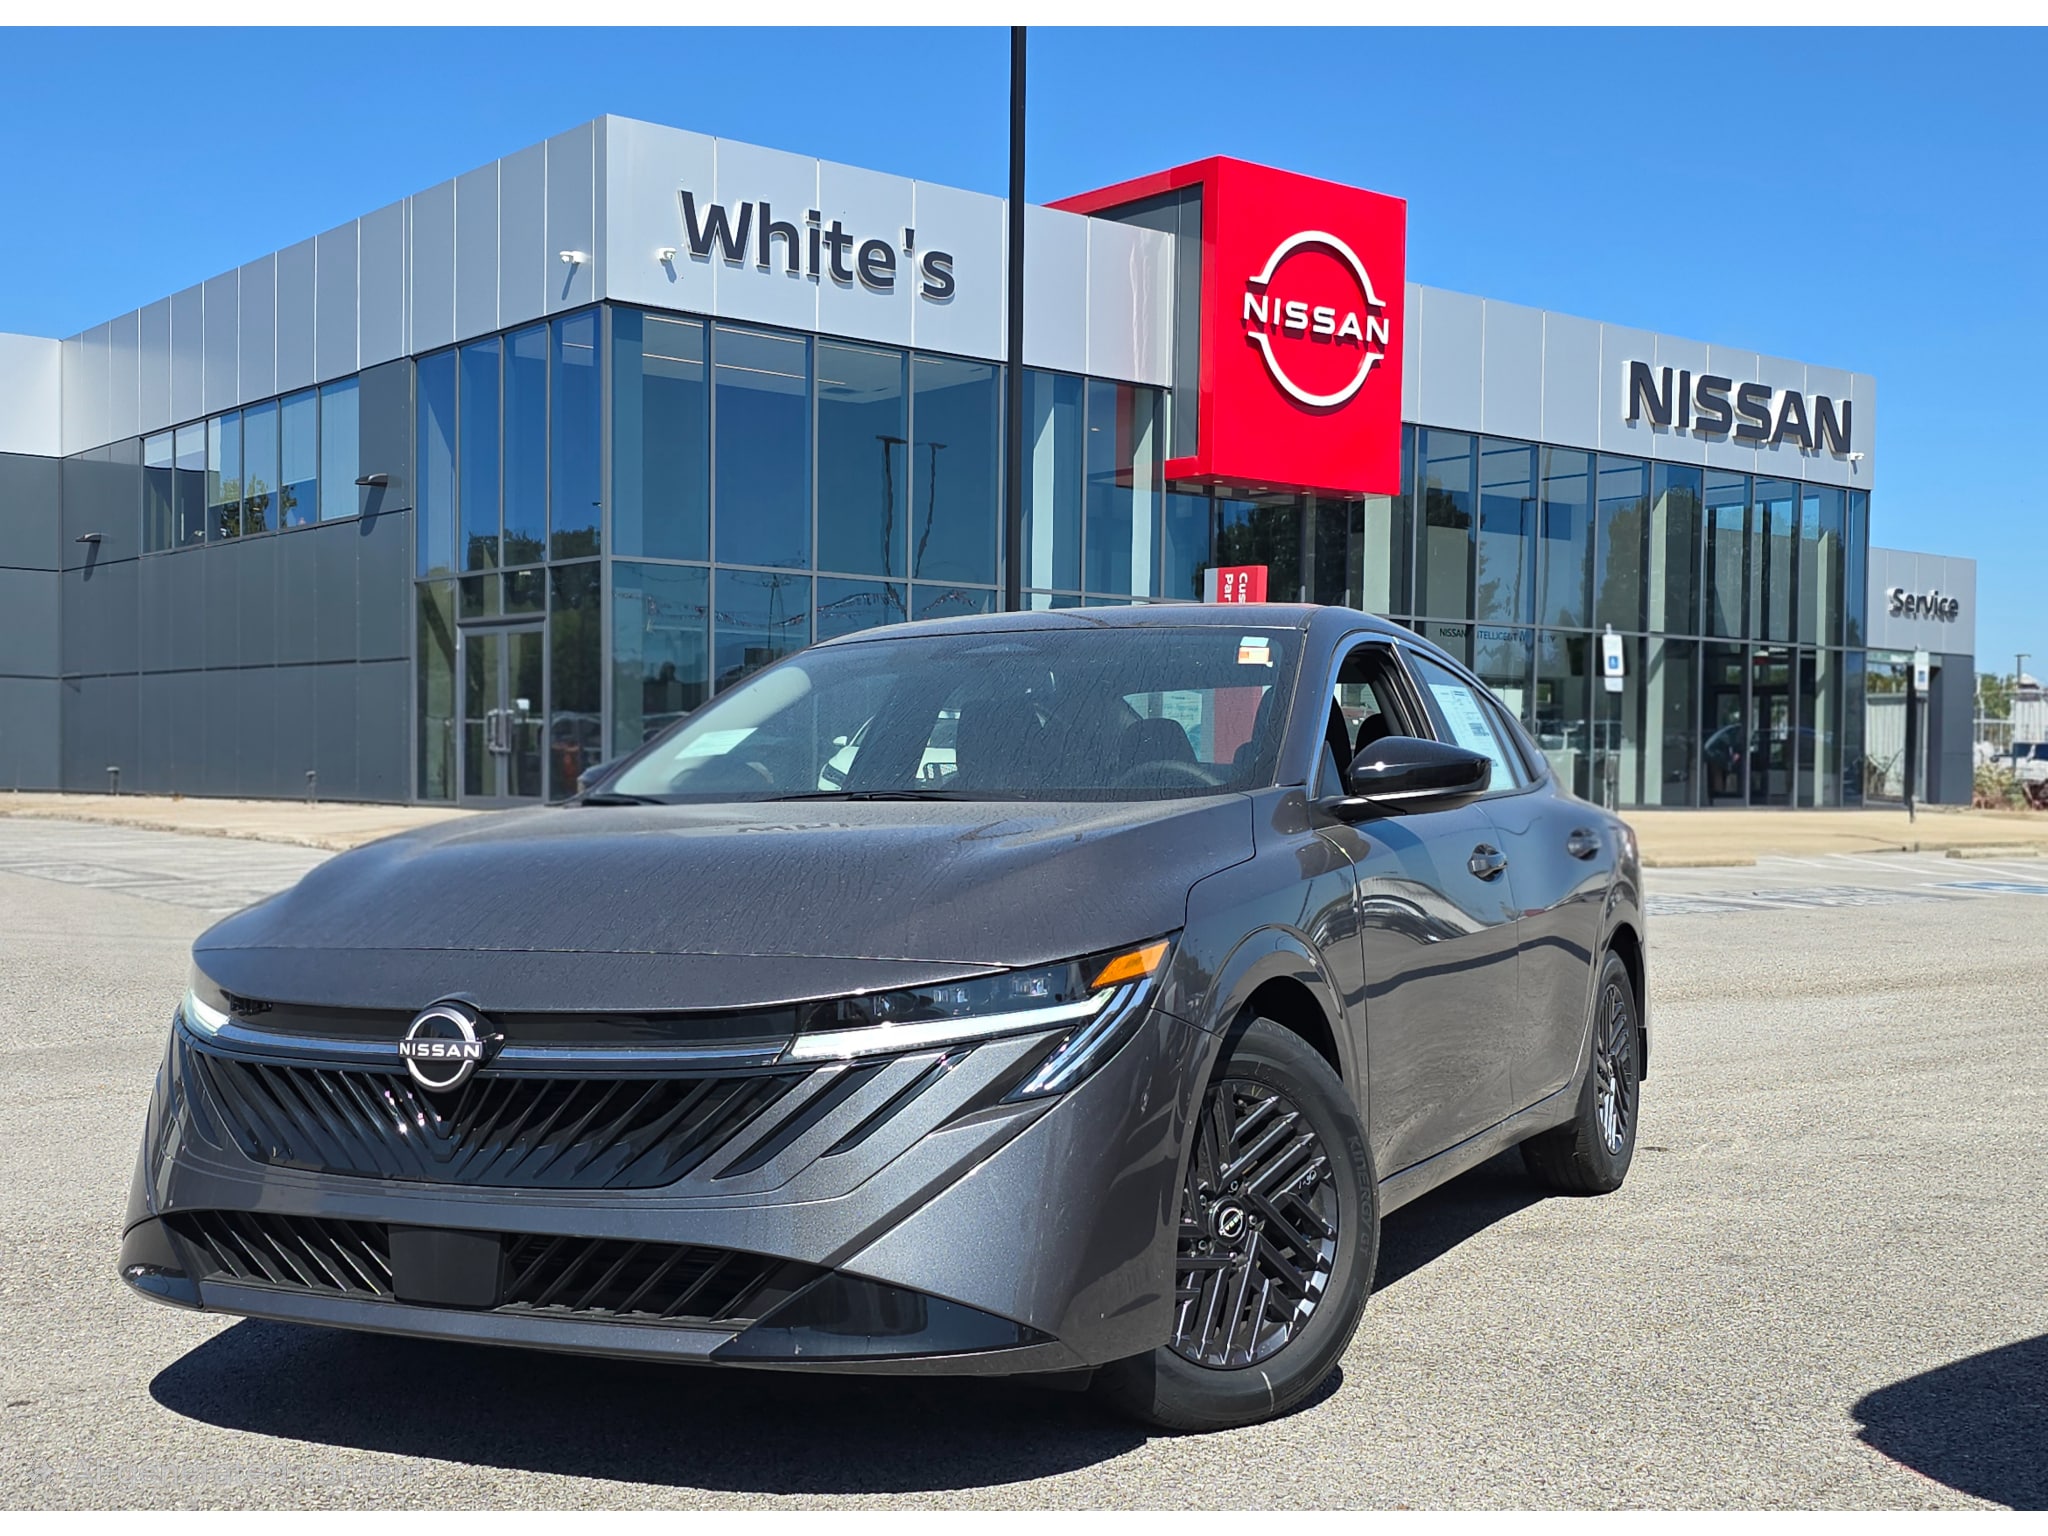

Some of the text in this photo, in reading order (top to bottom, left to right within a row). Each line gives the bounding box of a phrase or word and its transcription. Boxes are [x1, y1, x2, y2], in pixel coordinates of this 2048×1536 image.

[678, 190, 956, 299] White's
[1243, 292, 1389, 345] NISSAN
[1624, 360, 1852, 454] NISSAN
[1888, 588, 1959, 618] Service
[1440, 628, 1467, 638] NISSAN
[400, 1042, 480, 1058] NISSAN
